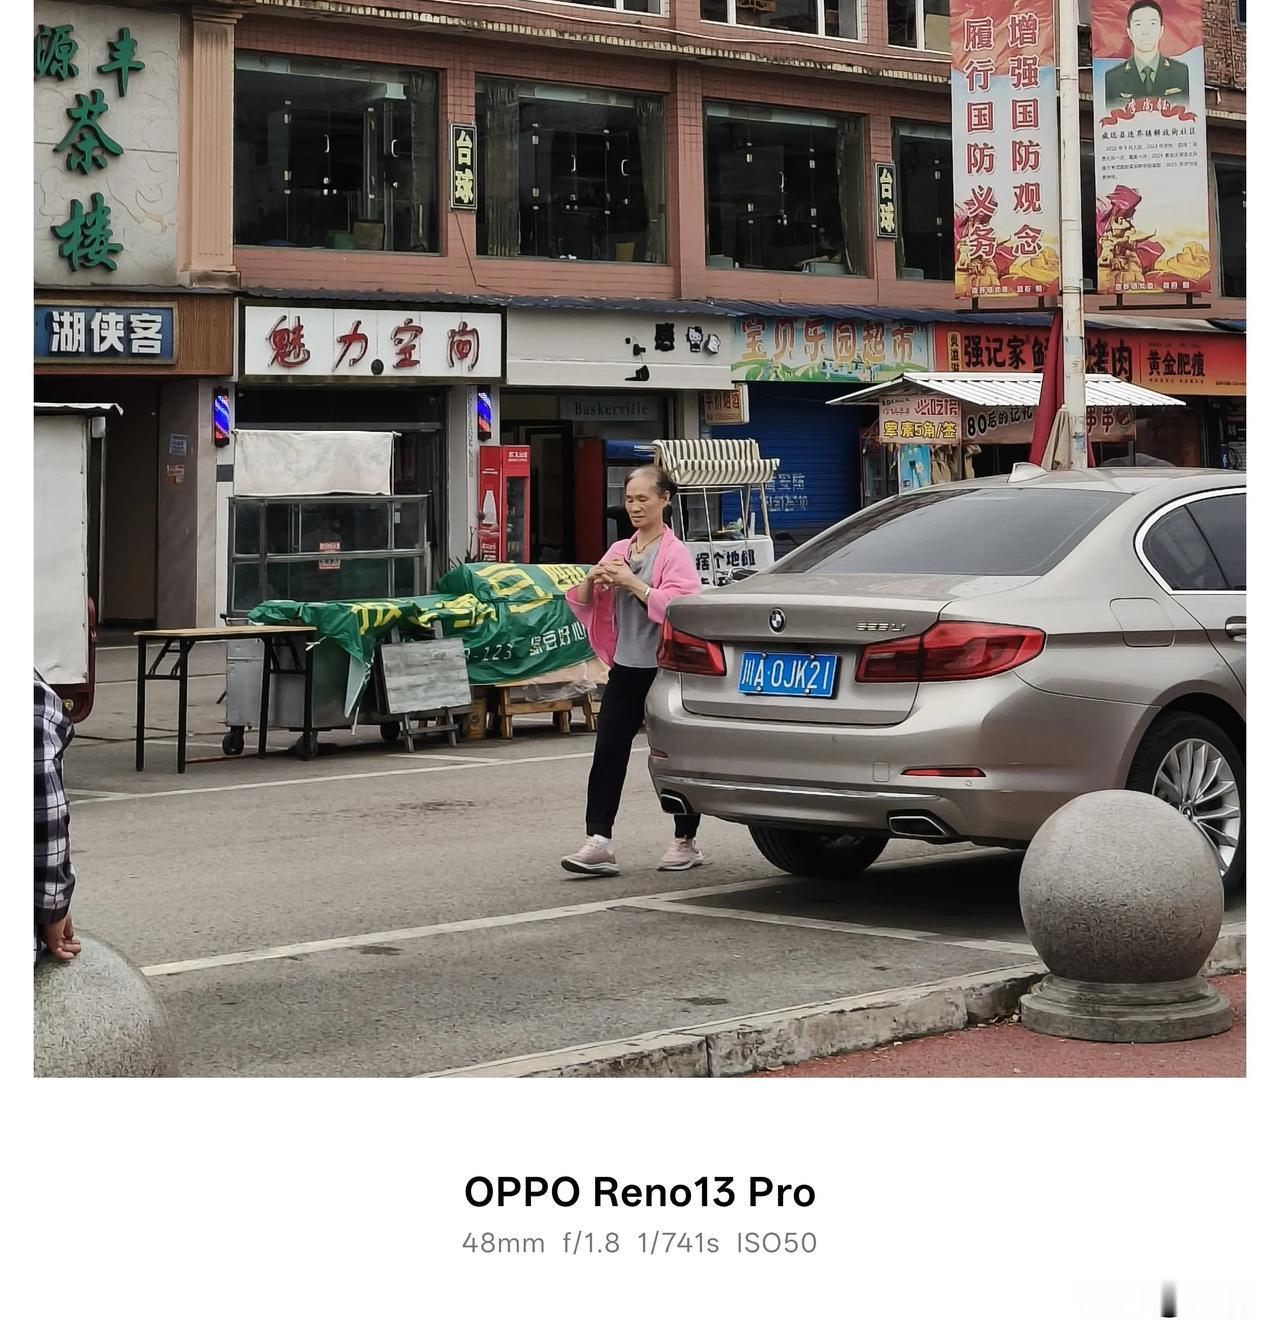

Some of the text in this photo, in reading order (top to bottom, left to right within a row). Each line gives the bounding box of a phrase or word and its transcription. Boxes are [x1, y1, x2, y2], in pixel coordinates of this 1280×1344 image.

[963, 16, 998, 258] 履行国防义务
[1008, 13, 1042, 257] 增强国防观念
[455, 130, 474, 204] 台球
[879, 168, 896, 233] 台球
[51, 311, 163, 355] 湖侠客
[265, 315, 480, 372] 魅力空间
[740, 317, 916, 366] 宝贝乐园超市
[1147, 349, 1206, 377] 黄金肥瘦
[575, 401, 649, 417] Baskerville
